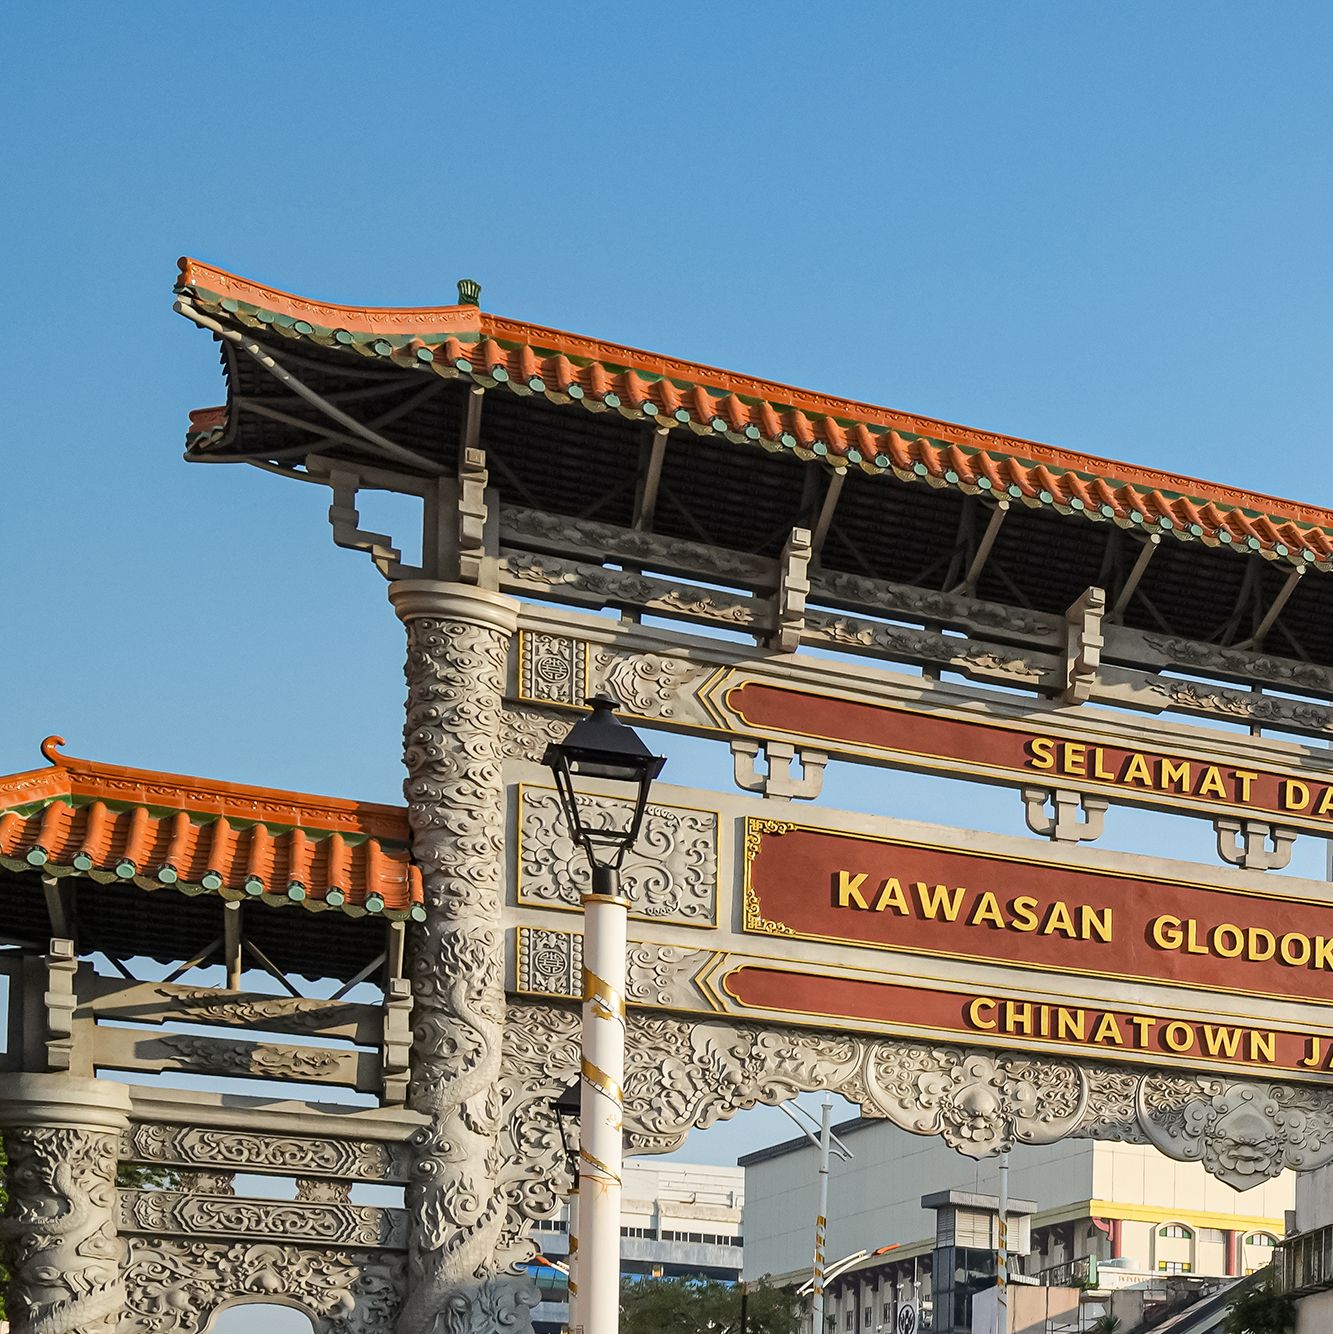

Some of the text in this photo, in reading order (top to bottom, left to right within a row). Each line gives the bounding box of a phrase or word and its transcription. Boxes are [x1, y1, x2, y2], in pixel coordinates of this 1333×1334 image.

[1029, 737, 1259, 803] SELAMAT
[836, 869, 1114, 943] KAWASAN
[968, 996, 1278, 1063] CHINATOWN
